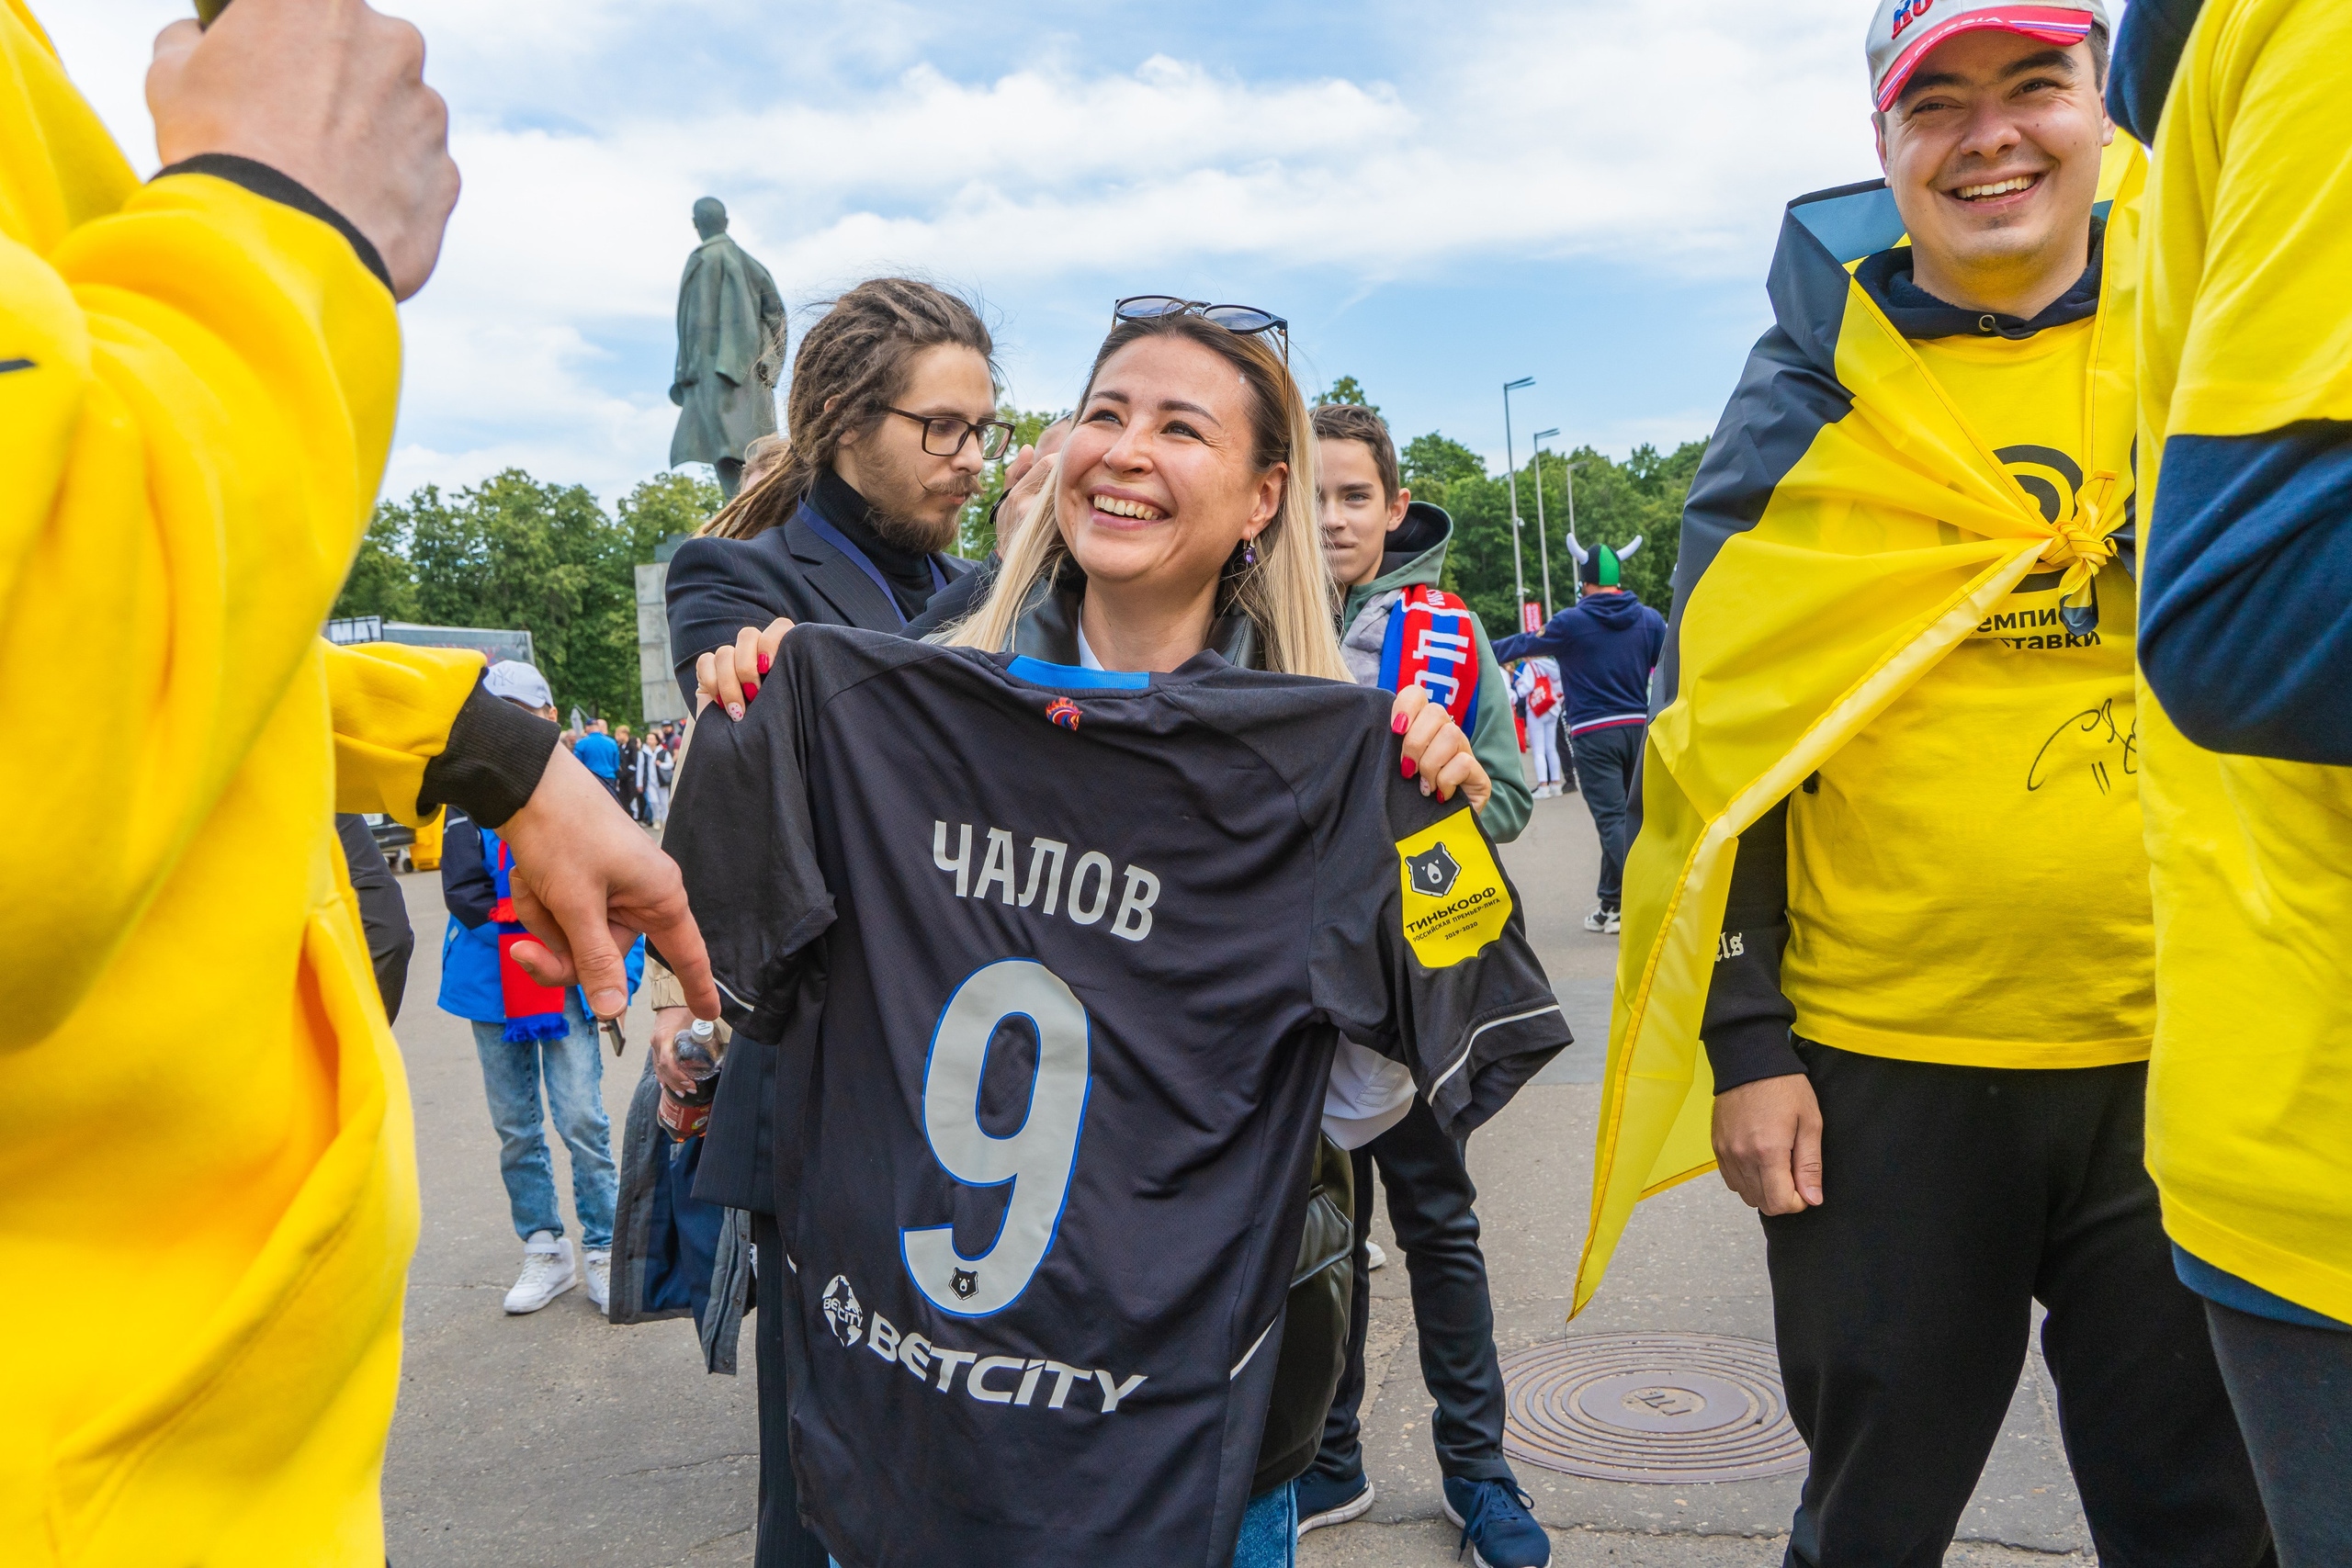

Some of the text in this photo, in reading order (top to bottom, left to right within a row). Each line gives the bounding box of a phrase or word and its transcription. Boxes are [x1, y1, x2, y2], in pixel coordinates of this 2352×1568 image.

[933, 820, 1160, 942] ЧАЛОВ
[1406, 886, 1496, 932] ТИНЬКОФФ
[1412, 897, 1501, 942] РОССИЙСКАЯ ПРЕМЬЕР-ЛИГА
[1444, 921, 1478, 941] 2019-2020
[899, 956, 1092, 1318] 9
[823, 1297, 864, 1328] BECITY
[867, 1311, 1149, 1413] BETCITY
